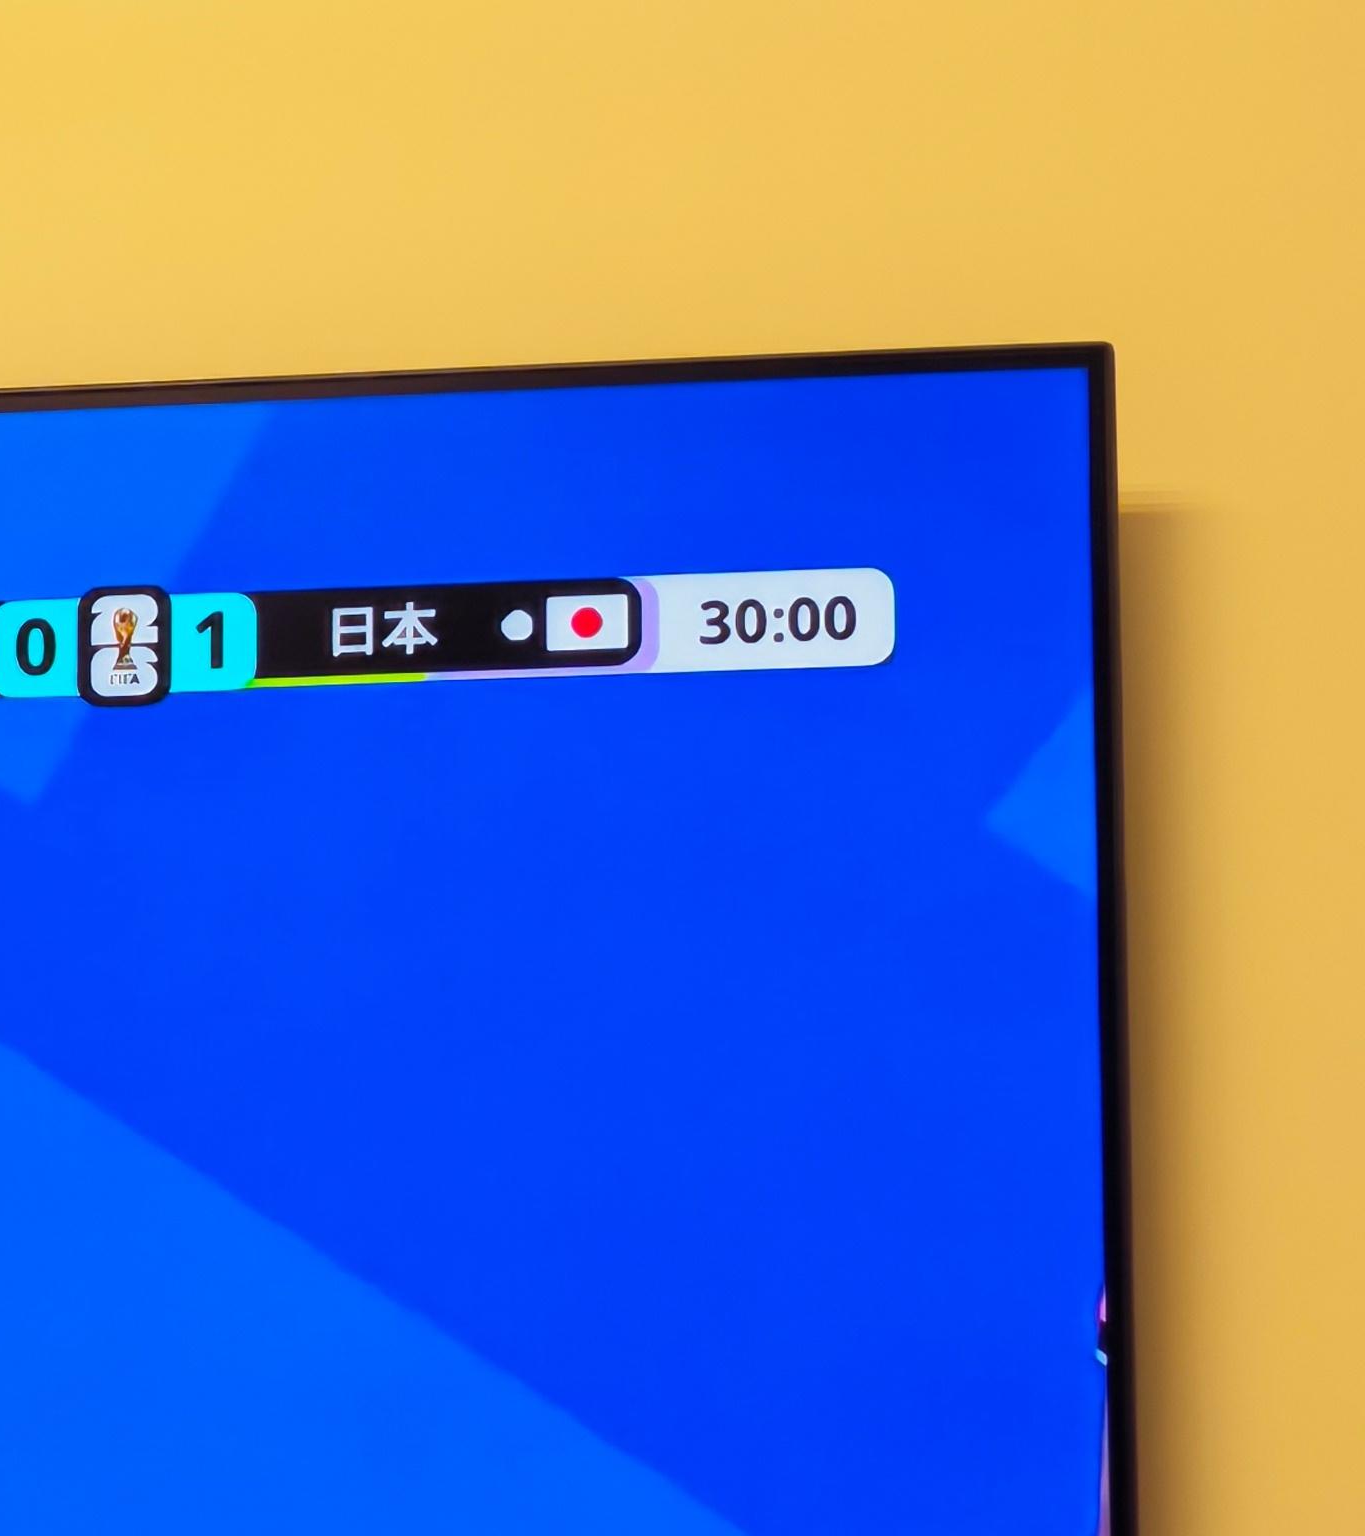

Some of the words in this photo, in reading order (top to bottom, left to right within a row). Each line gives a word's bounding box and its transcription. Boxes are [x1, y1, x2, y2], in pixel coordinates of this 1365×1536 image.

[14, 617, 57, 677] 0
[194, 610, 225, 670] 1
[331, 601, 439, 658] 日本
[698, 595, 858, 645] 30:00
